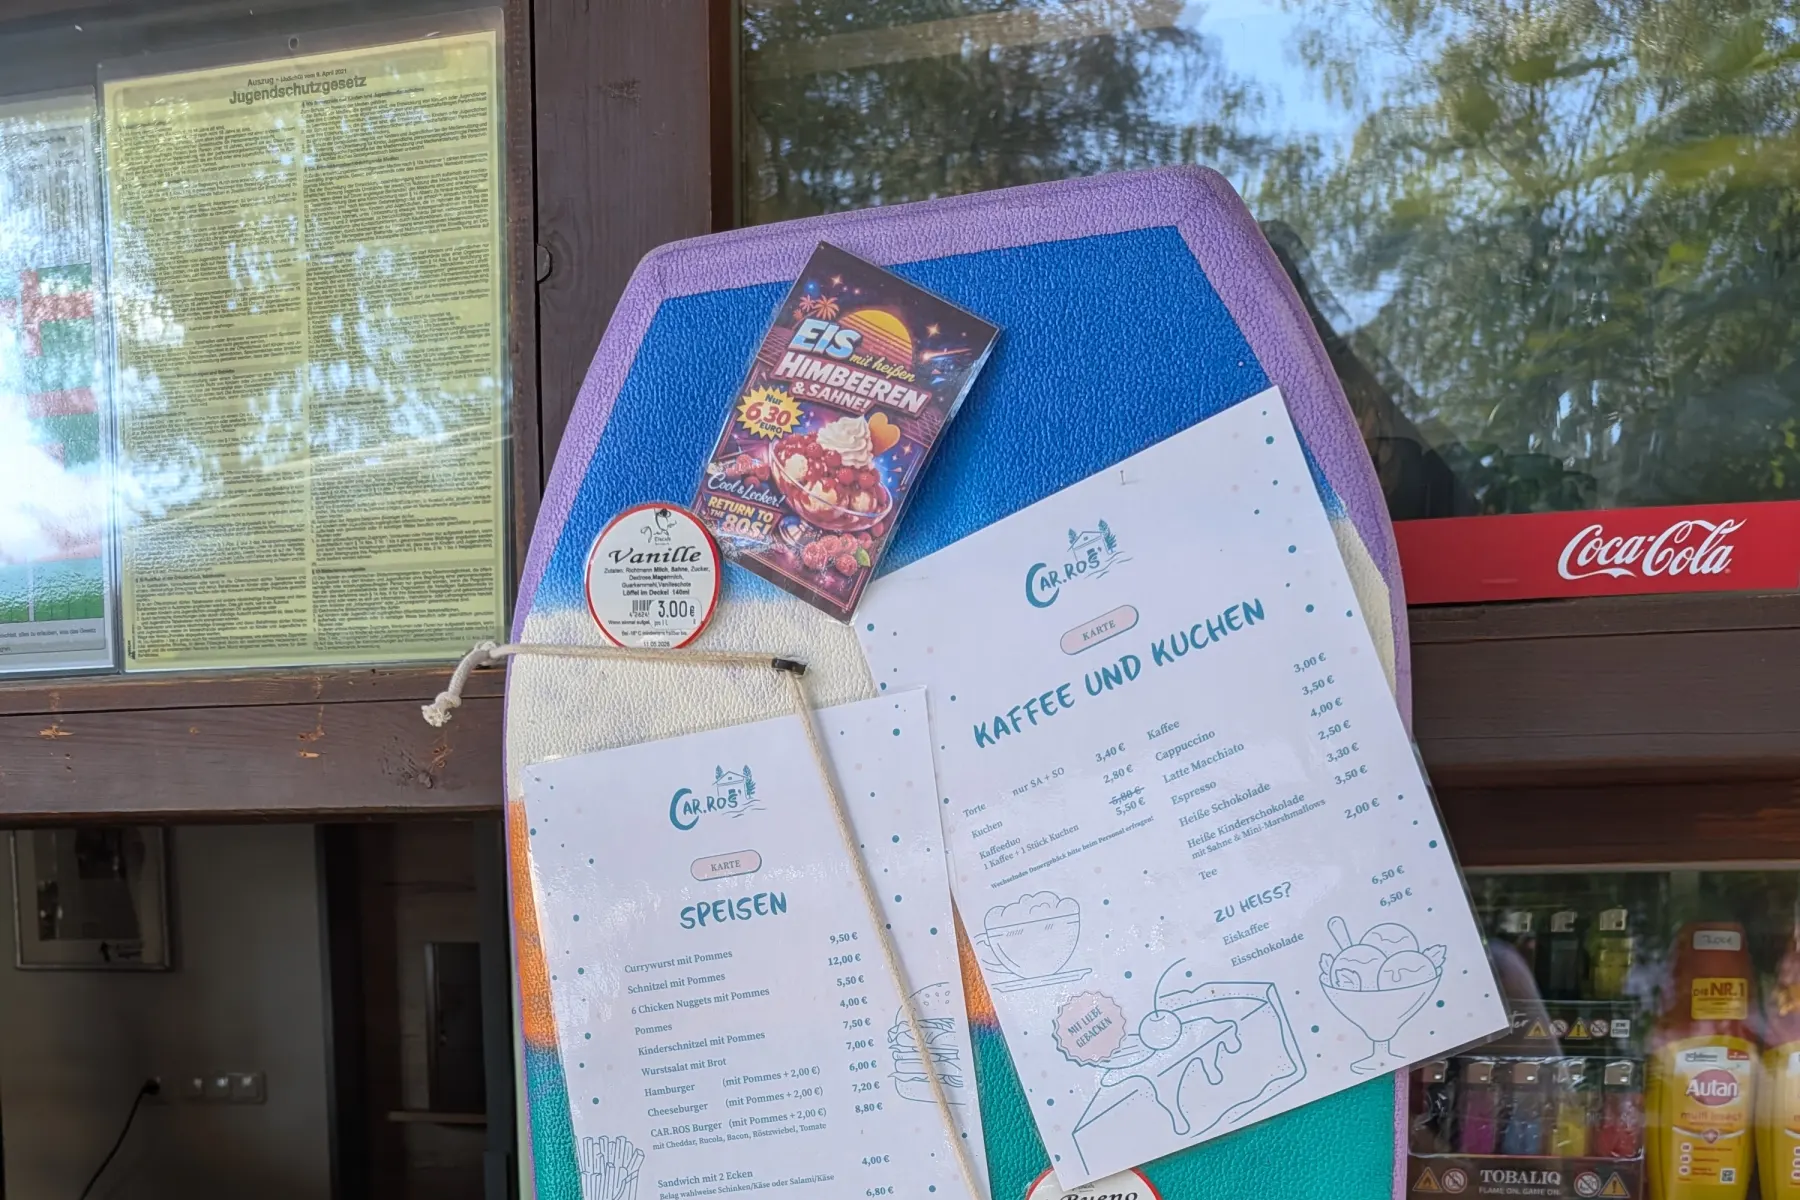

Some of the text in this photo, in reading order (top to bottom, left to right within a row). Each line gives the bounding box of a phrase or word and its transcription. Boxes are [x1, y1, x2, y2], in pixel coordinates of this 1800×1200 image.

[229, 76, 367, 105] Jugendschutzgesetz
[248, 77, 274, 87] Auszug
[788, 318, 862, 360] EIS
[850, 353, 916, 383] mit heißen
[774, 351, 928, 413] HIMBEEREN
[764, 393, 783, 406] Nur
[792, 381, 872, 413] & SAHNE!
[745, 401, 792, 426] 6,30
[759, 422, 783, 435] EURO
[708, 495, 773, 523] RETURN TO
[710, 509, 725, 518] THE
[608, 546, 702, 564] Vanille
[1557, 518, 1747, 580] Coca-Cola
[1082, 619, 1116, 642] KARTE
[973, 597, 1265, 749] KAFFEE UND KUCHEN
[1293, 652, 1327, 674] 3,00 €
[1146, 720, 1180, 741] Kaffee
[1095, 742, 1126, 763] 3,40 €
[1155, 730, 1216, 762] Cappuccino
[1326, 741, 1360, 763] 3,30 €
[1162, 743, 1245, 784] Latte Macchiato
[1012, 783, 1029, 797] nur
[1029, 777, 1044, 789] SA
[1051, 767, 1065, 779] SO
[1170, 781, 1217, 806] Espresso
[962, 803, 986, 818] Torte
[1178, 782, 1271, 828] Heiße Schokolade
[710, 859, 741, 872] KARTE
[1197, 868, 1218, 881] Tee
[679, 891, 787, 930] SPEISEN
[1213, 881, 1292, 924] ZU HEISS?
[829, 931, 859, 945] 9,50 €
[1222, 922, 1270, 946] Eiskaffee
[1230, 932, 1305, 967] Eisschokolade
[624, 950, 733, 974] Currywurst mit Pommes
[631, 988, 770, 1015] 6 Chicken Nuggets mit Pommes
[1067, 1005, 1103, 1036] MIT LIEBE
[1076, 1016, 1112, 1048] GEBACKEN
[637, 1032, 766, 1057] Kinderschnitzel mit Pommes
[640, 1058, 727, 1076] Wurstsalat mit Brot
[644, 1084, 696, 1097] Hamburger
[1686, 1079, 1738, 1097] Autan
[647, 1103, 709, 1118] Cheeseburger
[854, 1101, 883, 1115] 8,80 €
[650, 1122, 723, 1138] CAR.ROS Burger
[1480, 1169, 1561, 1186] TOBALIQ
